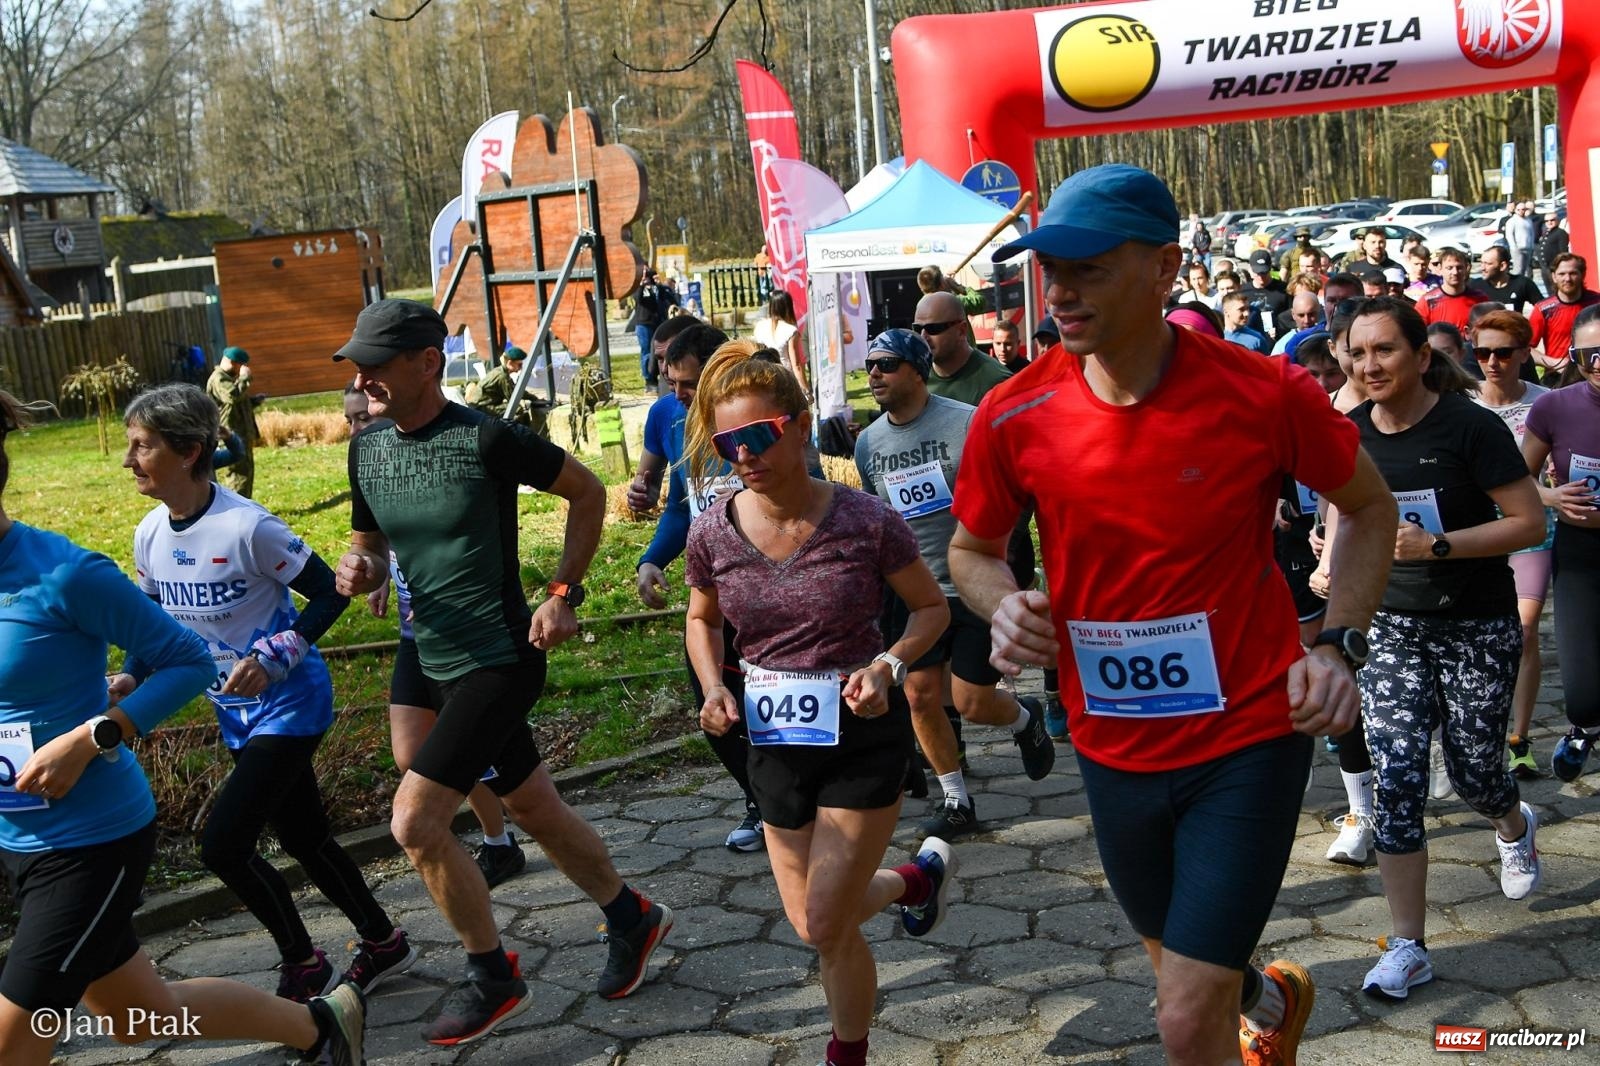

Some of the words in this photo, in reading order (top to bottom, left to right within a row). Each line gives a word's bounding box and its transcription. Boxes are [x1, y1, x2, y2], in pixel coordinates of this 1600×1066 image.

[1183, 16, 1421, 65] TWARDZIELA
[1208, 60, 1398, 101] RACIBÓRZ
[872, 440, 951, 472] CrossFit
[899, 481, 936, 506] 069
[153, 579, 248, 607] UNNERS
[174, 613, 198, 622] OKNA
[200, 611, 233, 623] TEAM
[1077, 628, 1093, 638] XIV
[1097, 629, 1122, 639] BIEG
[1124, 621, 1197, 639] TWARDZIELA
[780, 672, 832, 682] TWARDZIELA
[1098, 652, 1190, 691] 086
[756, 694, 820, 724] 049
